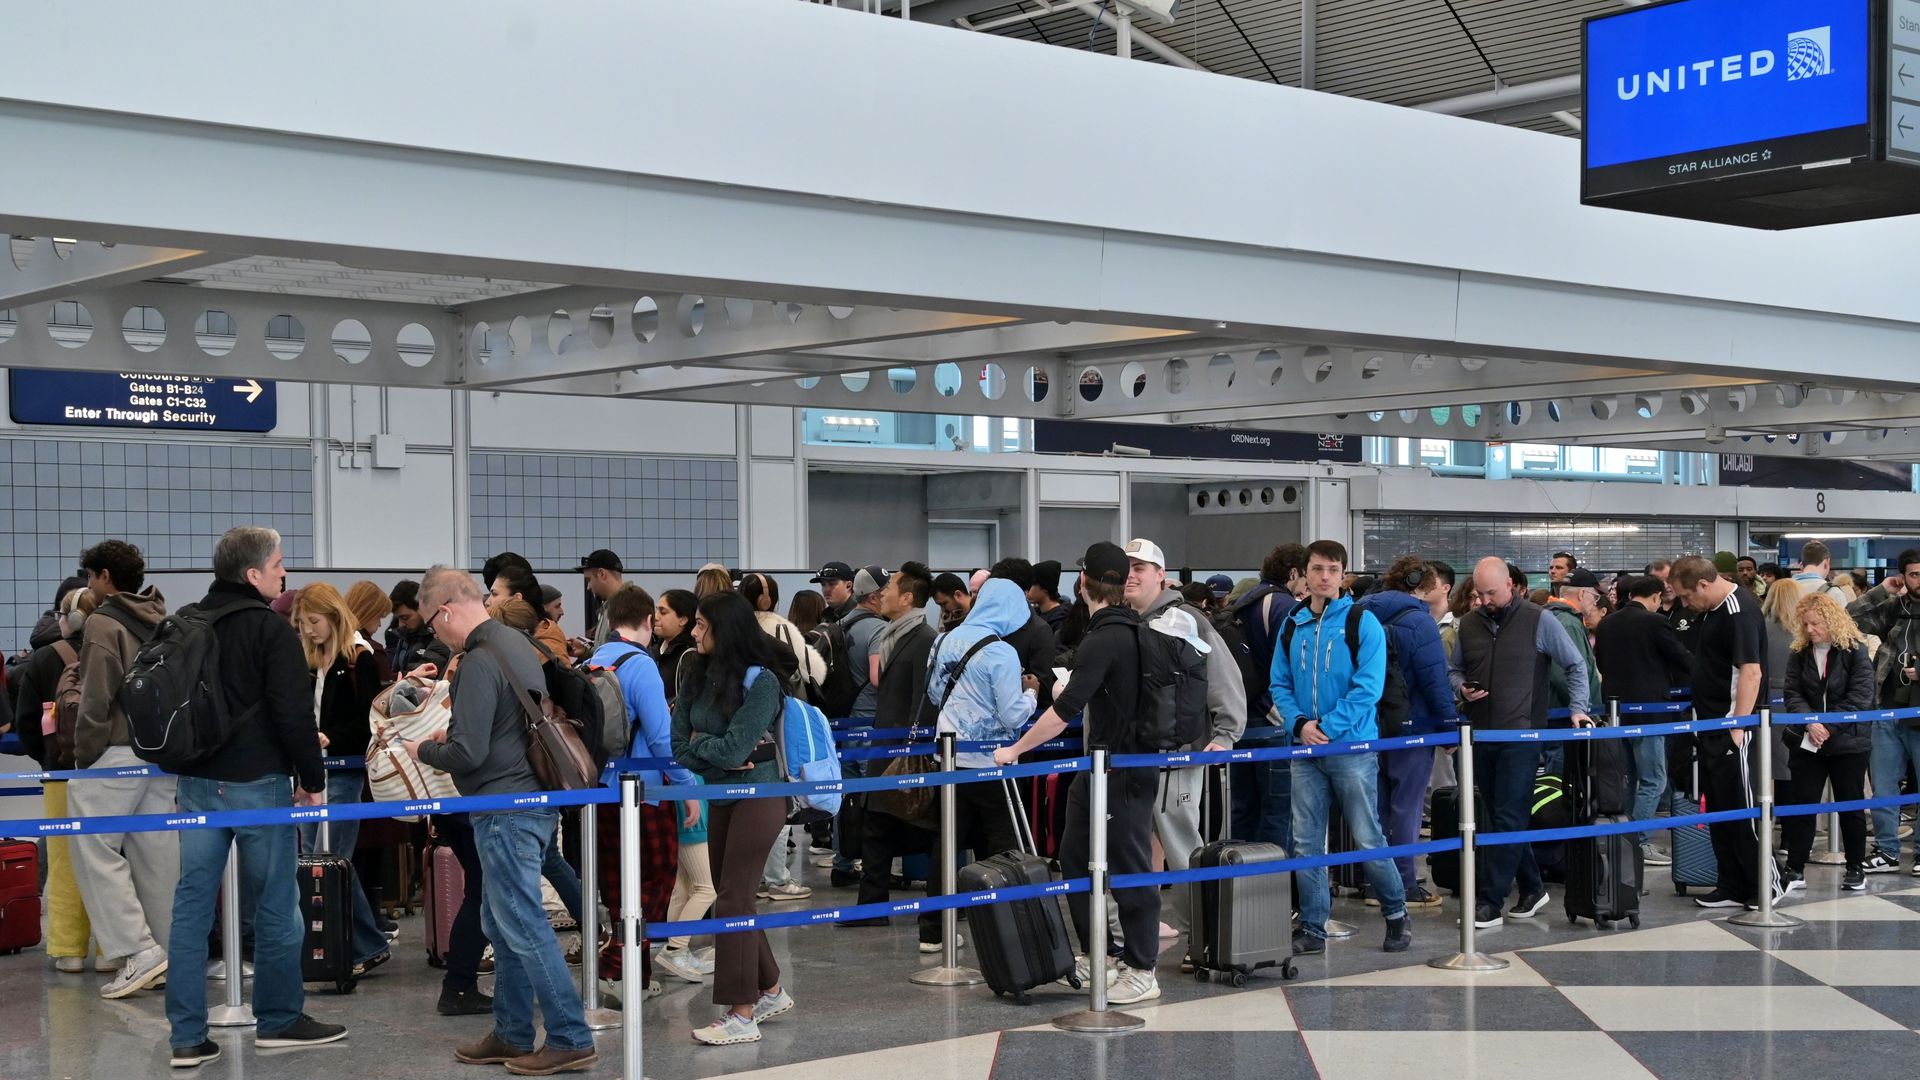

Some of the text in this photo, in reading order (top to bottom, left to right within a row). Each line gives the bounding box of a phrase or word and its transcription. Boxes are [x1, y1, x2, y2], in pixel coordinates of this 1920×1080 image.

[1617, 49, 1775, 101] UNITED
[1668, 152, 1758, 175] STAR ALLIANCE
[129, 382, 204, 395] Gates B1-B24
[129, 395, 207, 409] Gates C1-C32
[65, 406, 216, 425] Enter Through Security
[1231, 434, 1271, 447] ORDNext.org
[1722, 453, 1754, 473] CHICAGO
[1816, 492, 1826, 514] 8
[290, 810, 320, 819] UNITED
[39, 824, 72, 832] UNITED
[166, 817, 198, 826] UNITED
[893, 904, 914, 912] UNITED
